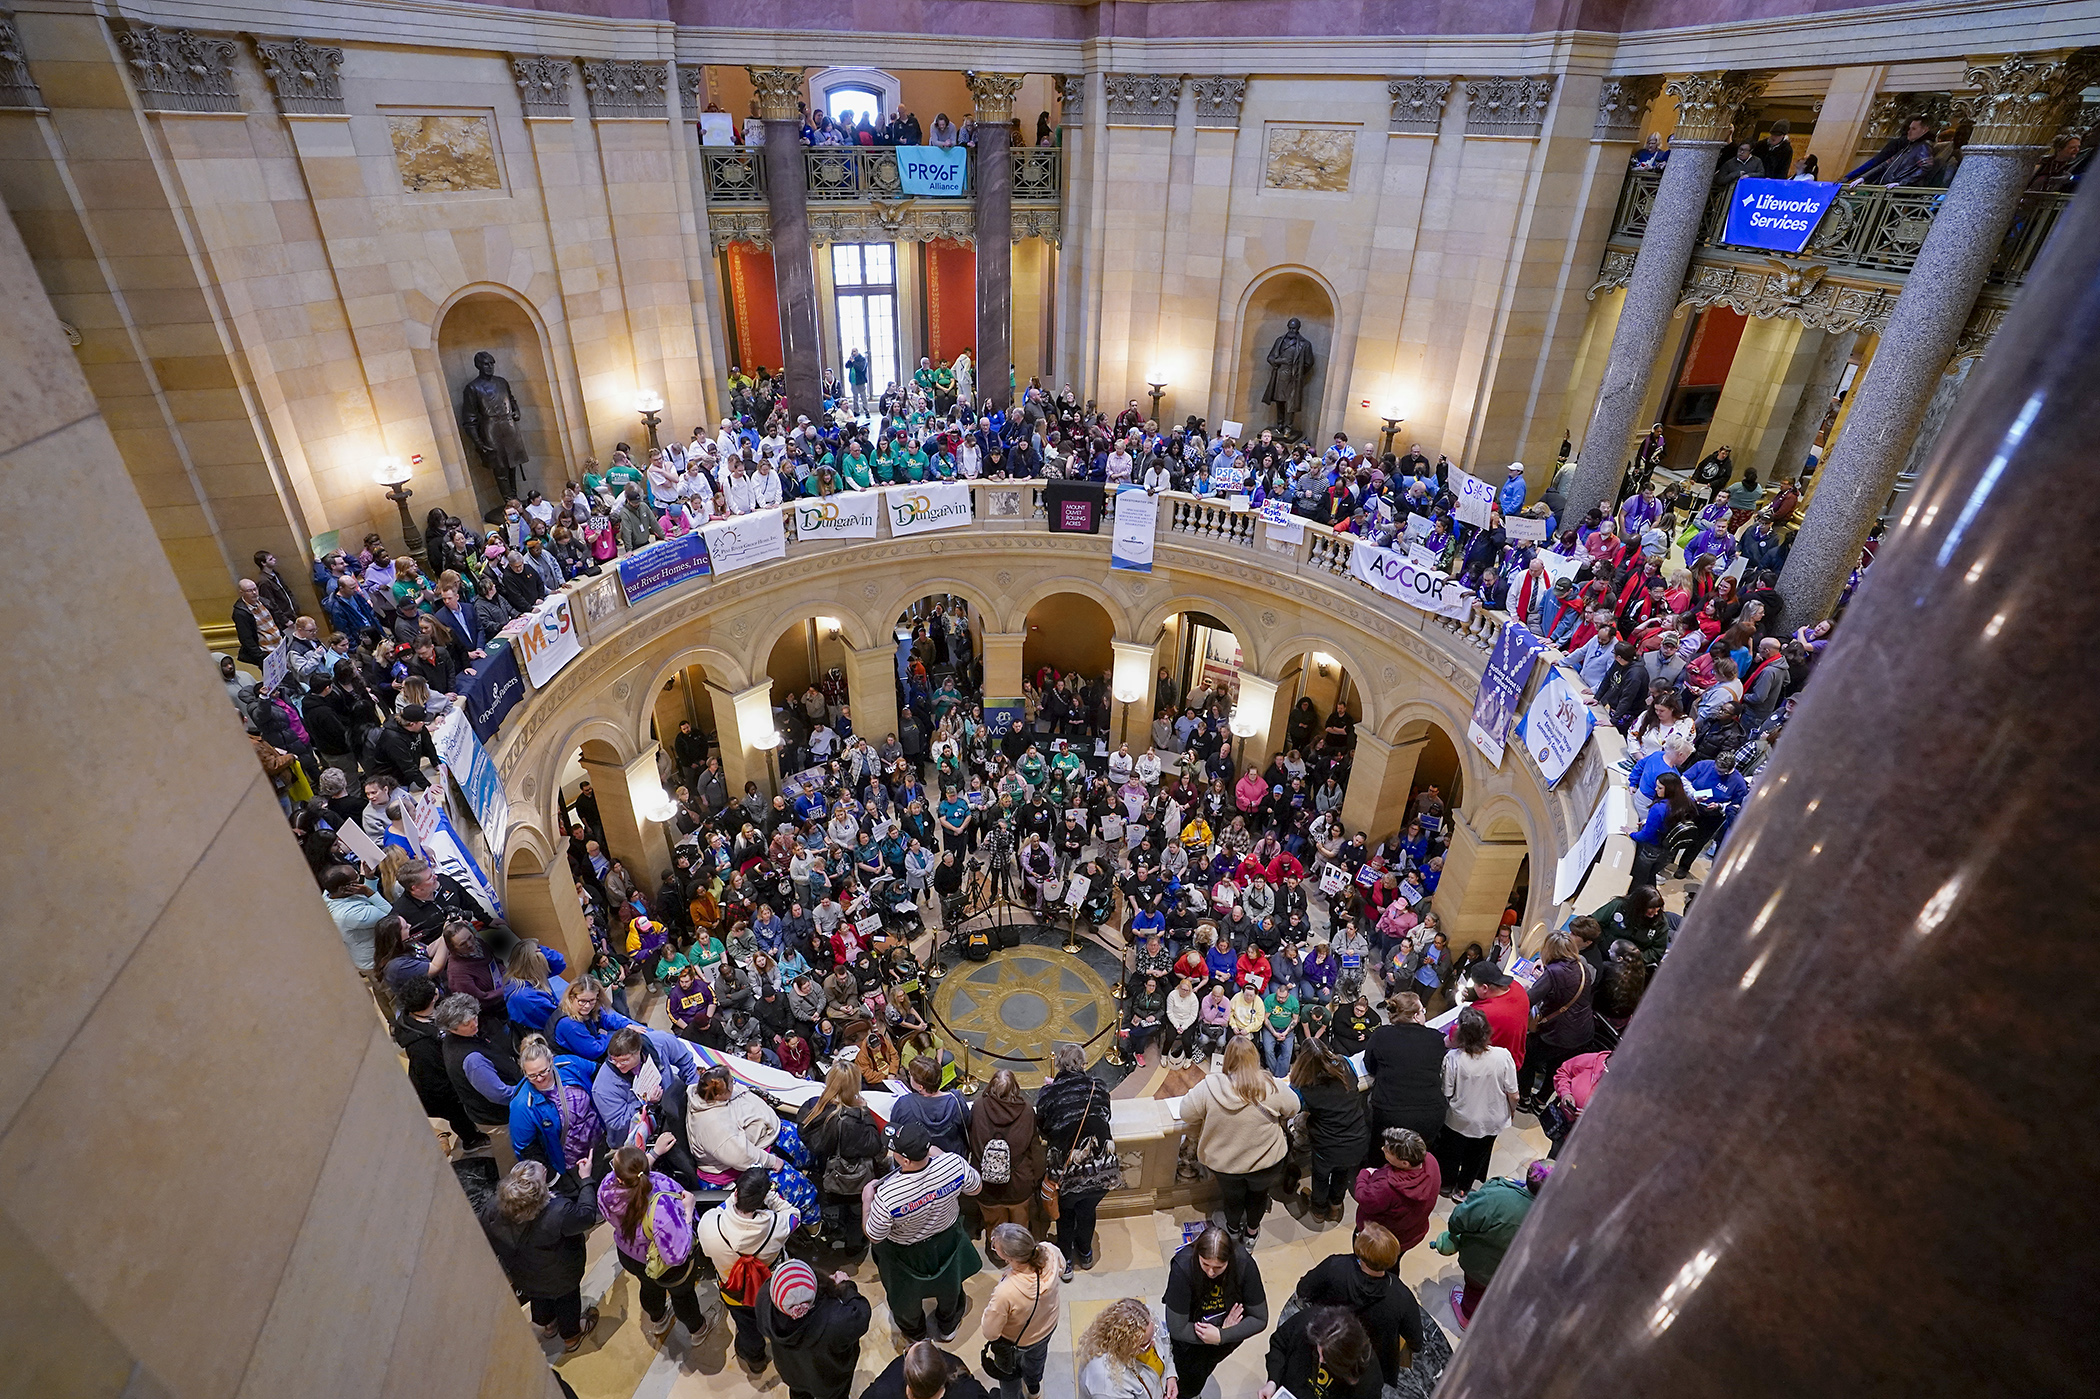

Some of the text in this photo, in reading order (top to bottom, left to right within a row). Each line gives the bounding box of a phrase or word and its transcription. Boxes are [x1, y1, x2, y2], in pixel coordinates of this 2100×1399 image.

[929, 182, 959, 190] Alliance
[1756, 194, 1820, 213] Lifeworks
[1750, 212, 1808, 231] Services
[799, 503, 873, 531] Dungarvin
[891, 502, 967, 526] Dungarvin
[641, 572, 660, 587] River
[661, 561, 692, 578] Homes,
[522, 602, 570, 663] MSS
[1488, 663, 1506, 679] Nothing
[1504, 676, 1518, 688] About
[1491, 675, 1509, 690] Without
